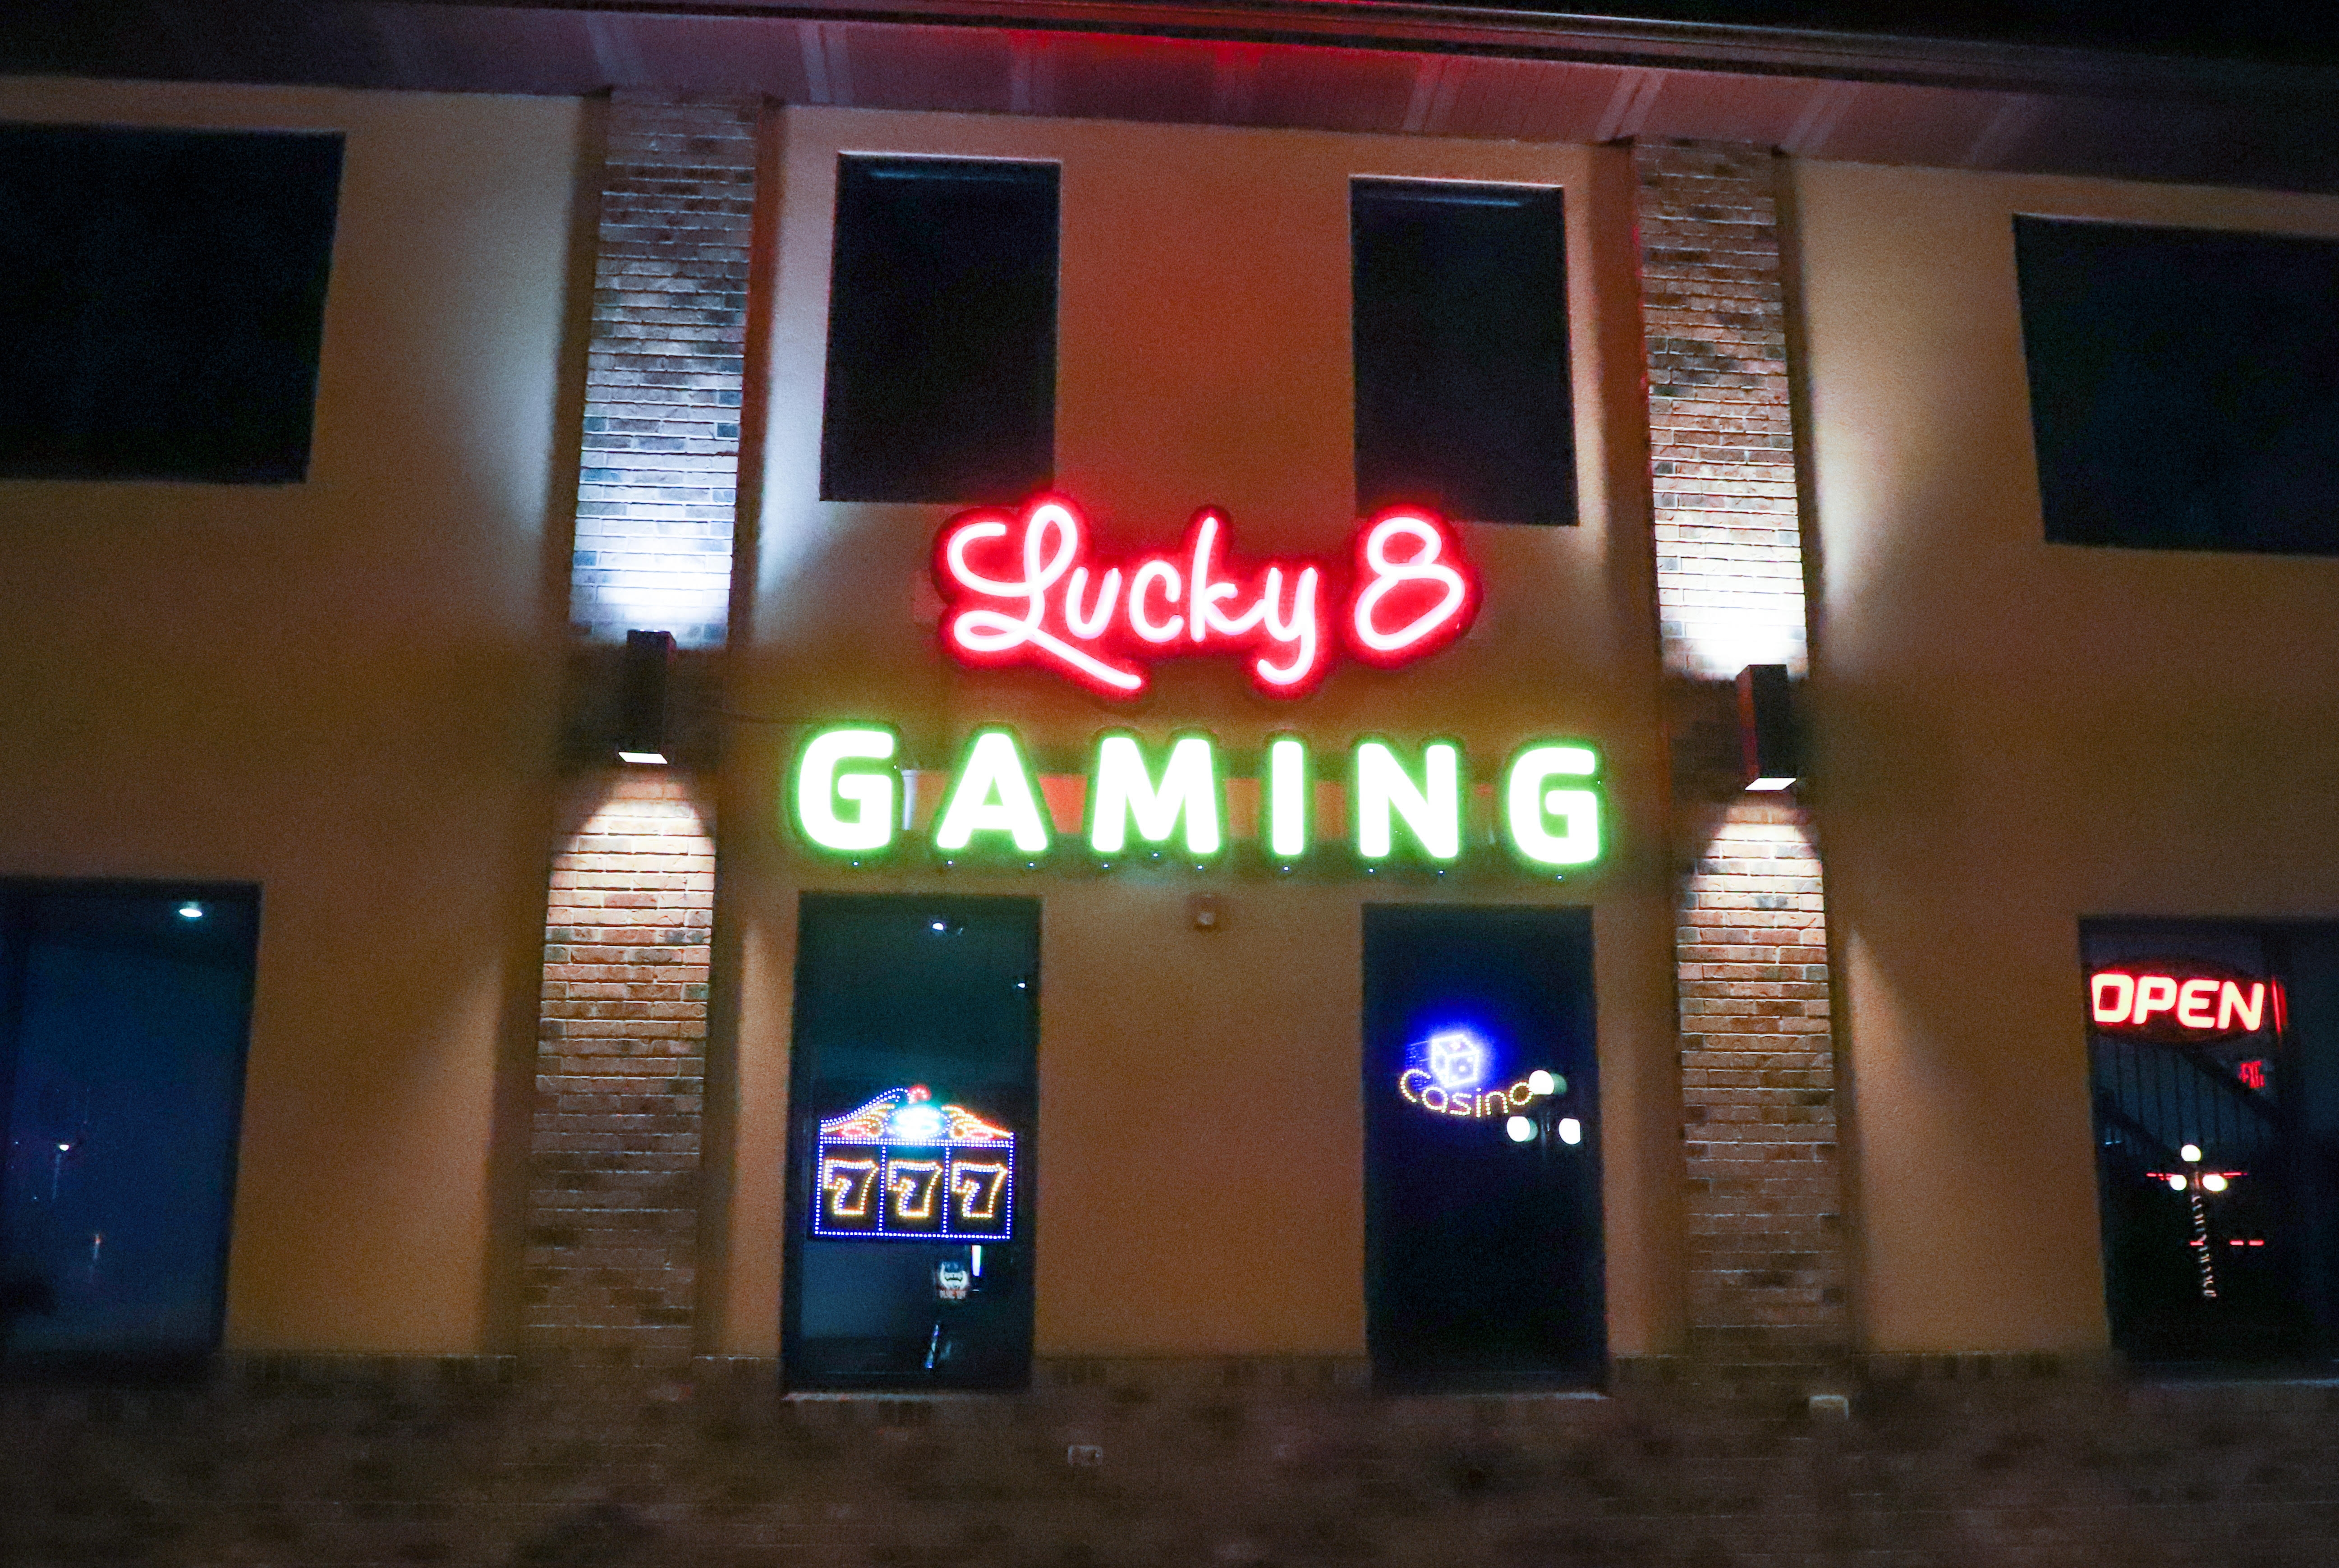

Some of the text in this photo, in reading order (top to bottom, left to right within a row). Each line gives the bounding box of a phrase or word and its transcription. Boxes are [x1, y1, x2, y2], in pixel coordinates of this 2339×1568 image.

[947, 504, 1465, 690] Lucky 8
[797, 728, 1600, 865] GAMING
[2091, 972, 2265, 1031] OPEN
[1399, 1068, 1534, 1118] Casino
